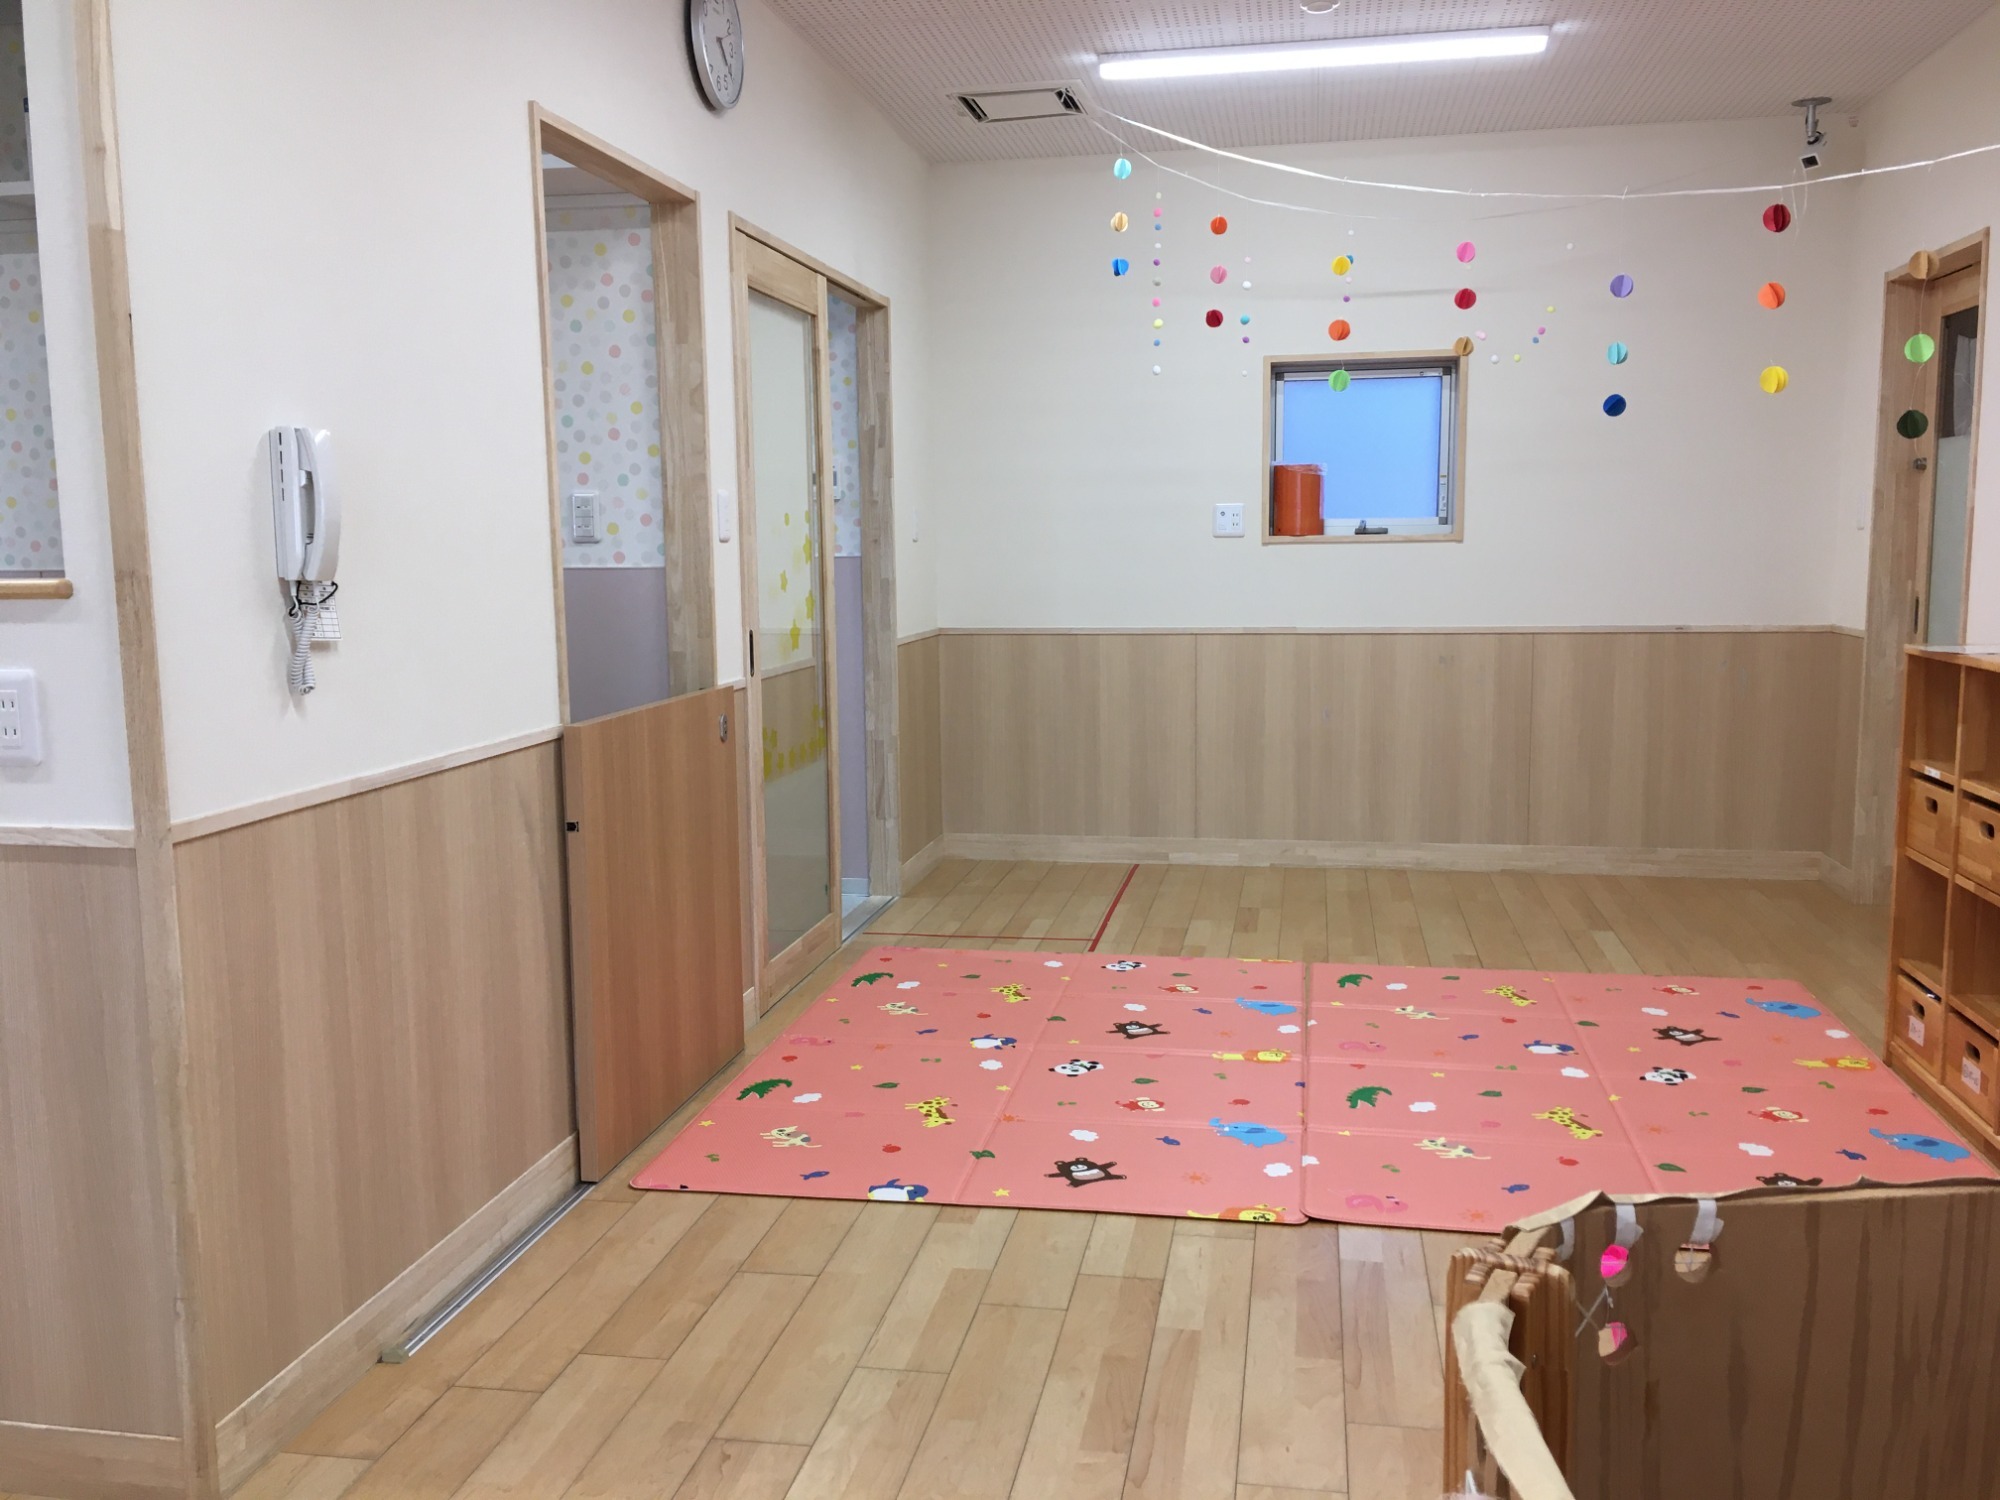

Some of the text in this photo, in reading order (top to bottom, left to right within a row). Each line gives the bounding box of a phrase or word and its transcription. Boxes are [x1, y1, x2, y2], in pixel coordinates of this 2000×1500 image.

[726, 18, 732, 36] 2
[729, 42, 734, 59] 3
[716, 75, 722, 92] 6
[723, 74, 729, 91] 5
